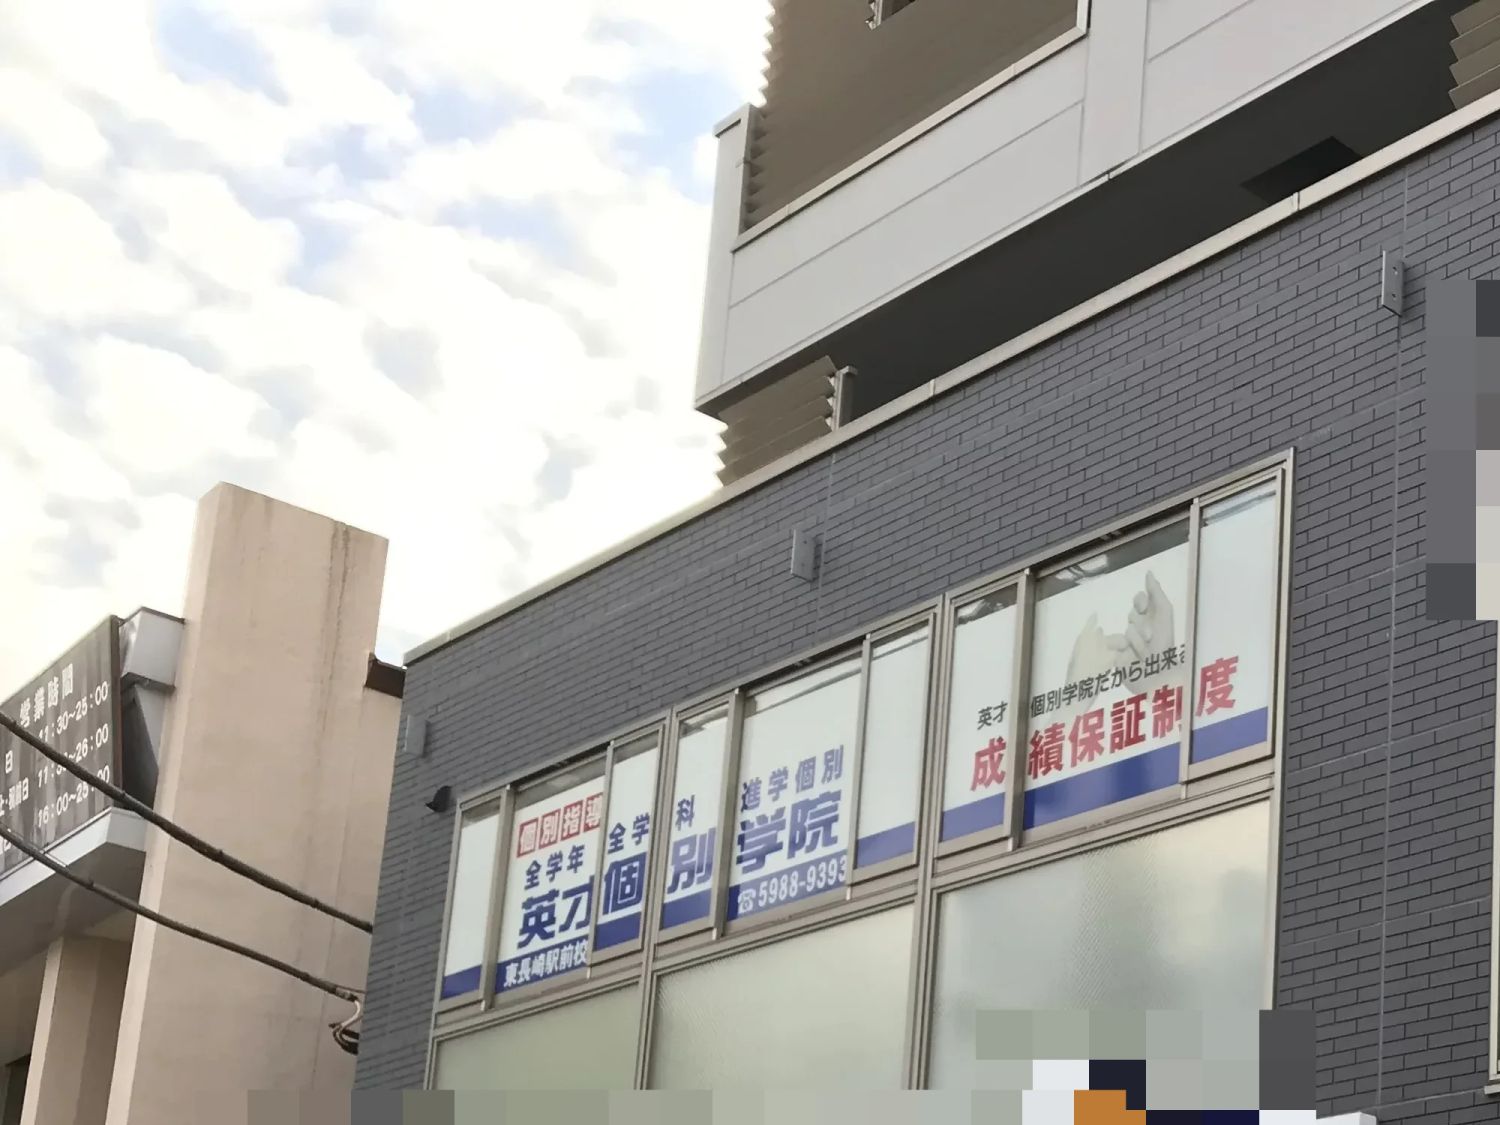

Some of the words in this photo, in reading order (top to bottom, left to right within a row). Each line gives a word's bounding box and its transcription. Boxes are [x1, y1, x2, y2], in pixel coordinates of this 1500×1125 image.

[970, 656, 1239, 792] 成績保証制度
[519, 794, 603, 856] 個別指導
[524, 844, 586, 890] 全学年
[503, 938, 588, 989] 東長崎駅前校
